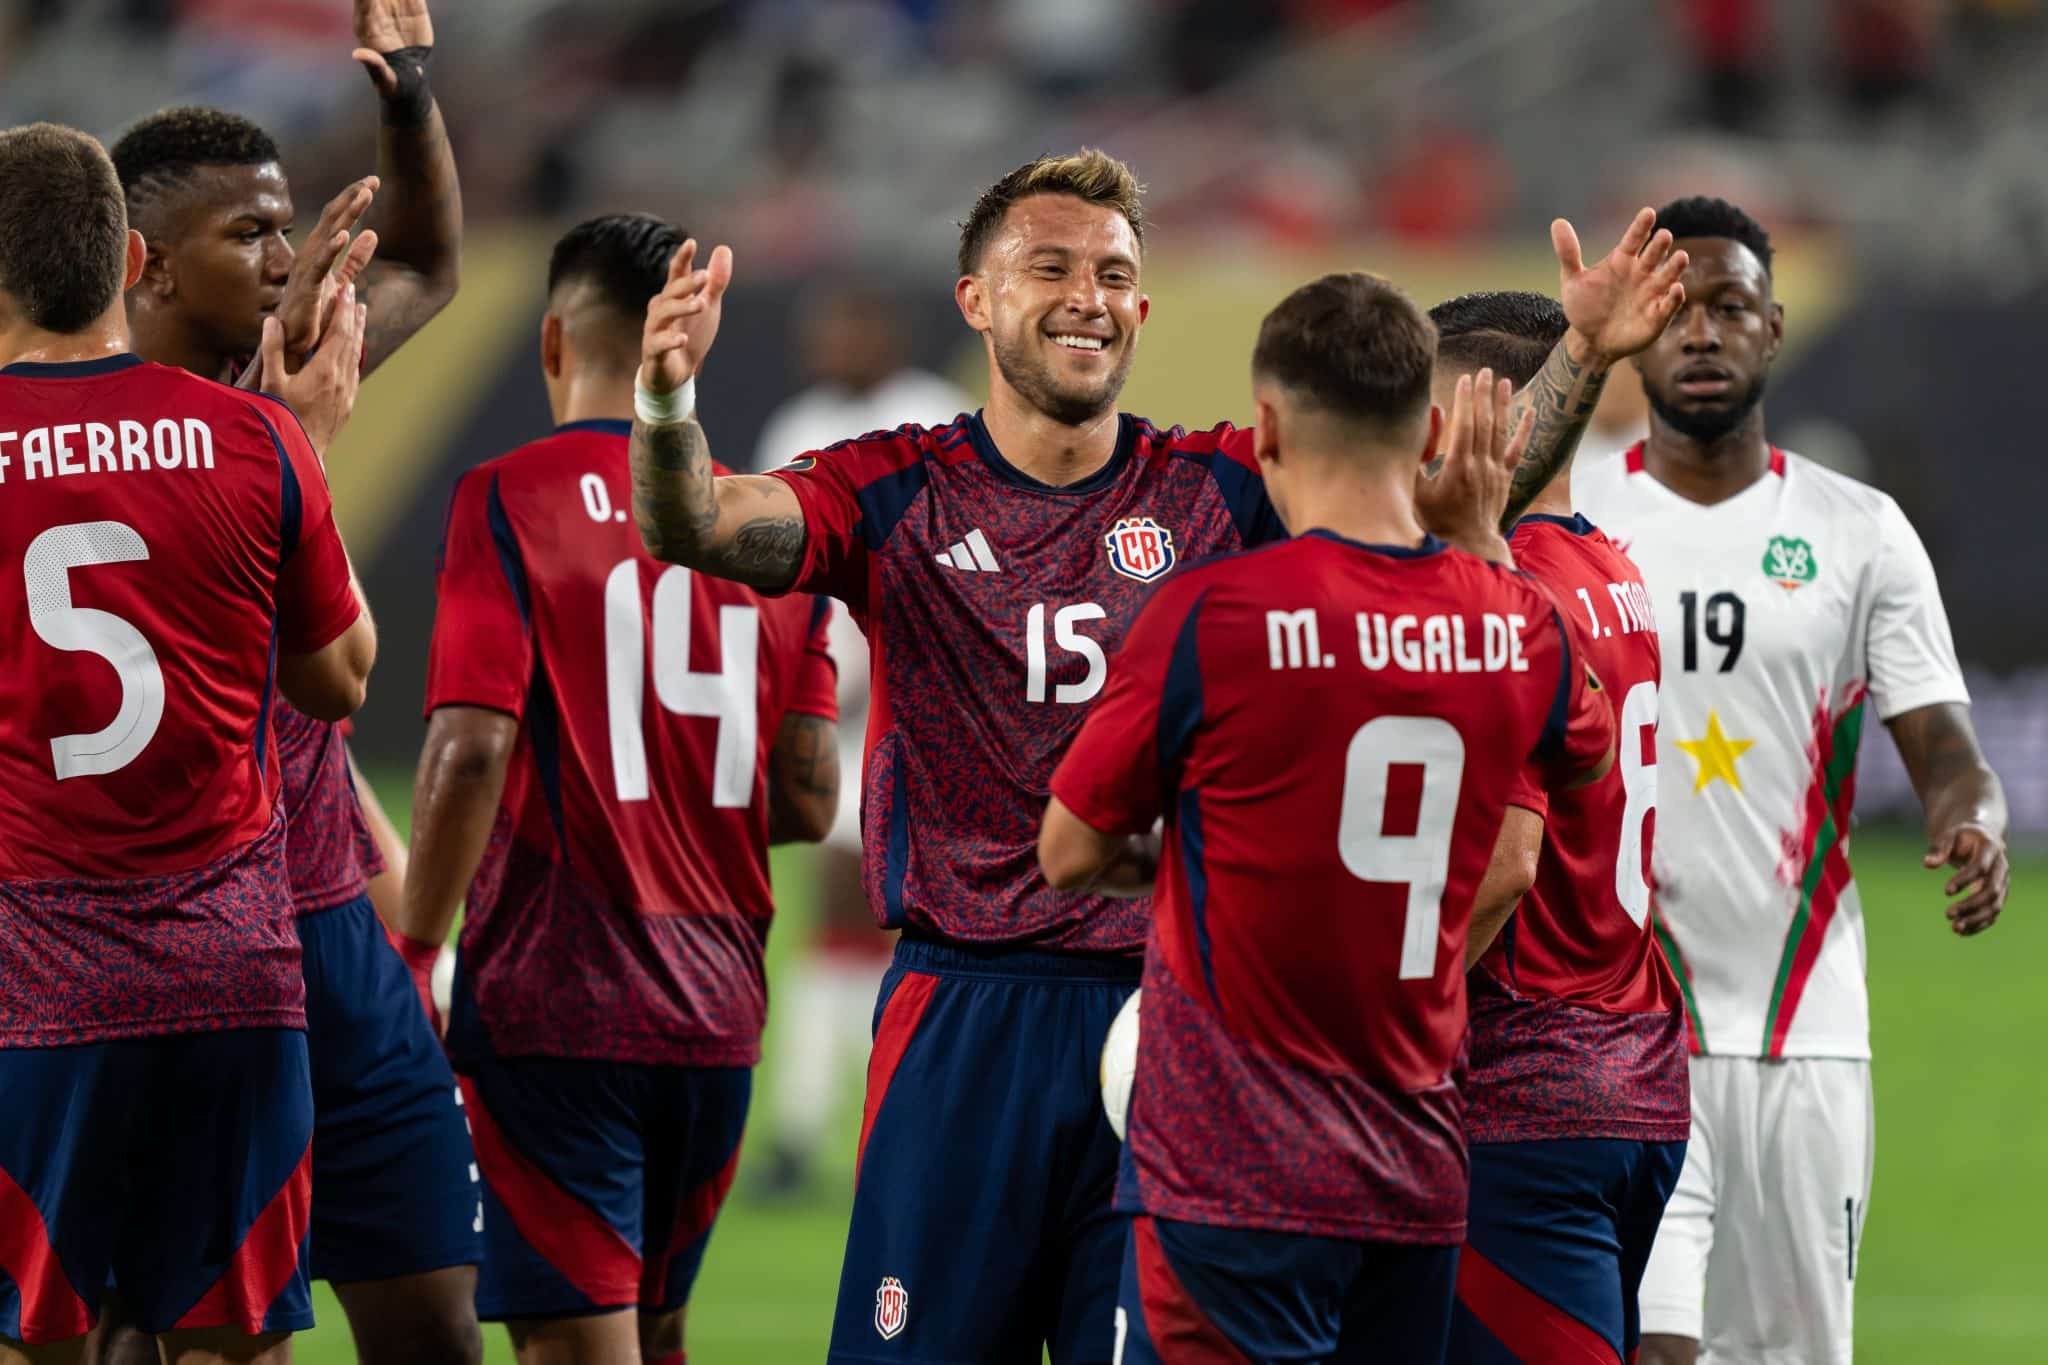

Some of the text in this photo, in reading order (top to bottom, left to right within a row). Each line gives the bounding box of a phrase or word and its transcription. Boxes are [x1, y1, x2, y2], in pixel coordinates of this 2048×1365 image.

[0, 418, 215, 484] FAERRON
[24, 520, 165, 781] 5
[605, 558, 759, 808] 14
[1026, 602, 1107, 704] 15
[1266, 608, 1529, 672] M. UGALDE
[1679, 591, 1746, 675] 19
[1337, 715, 1466, 980] 9
